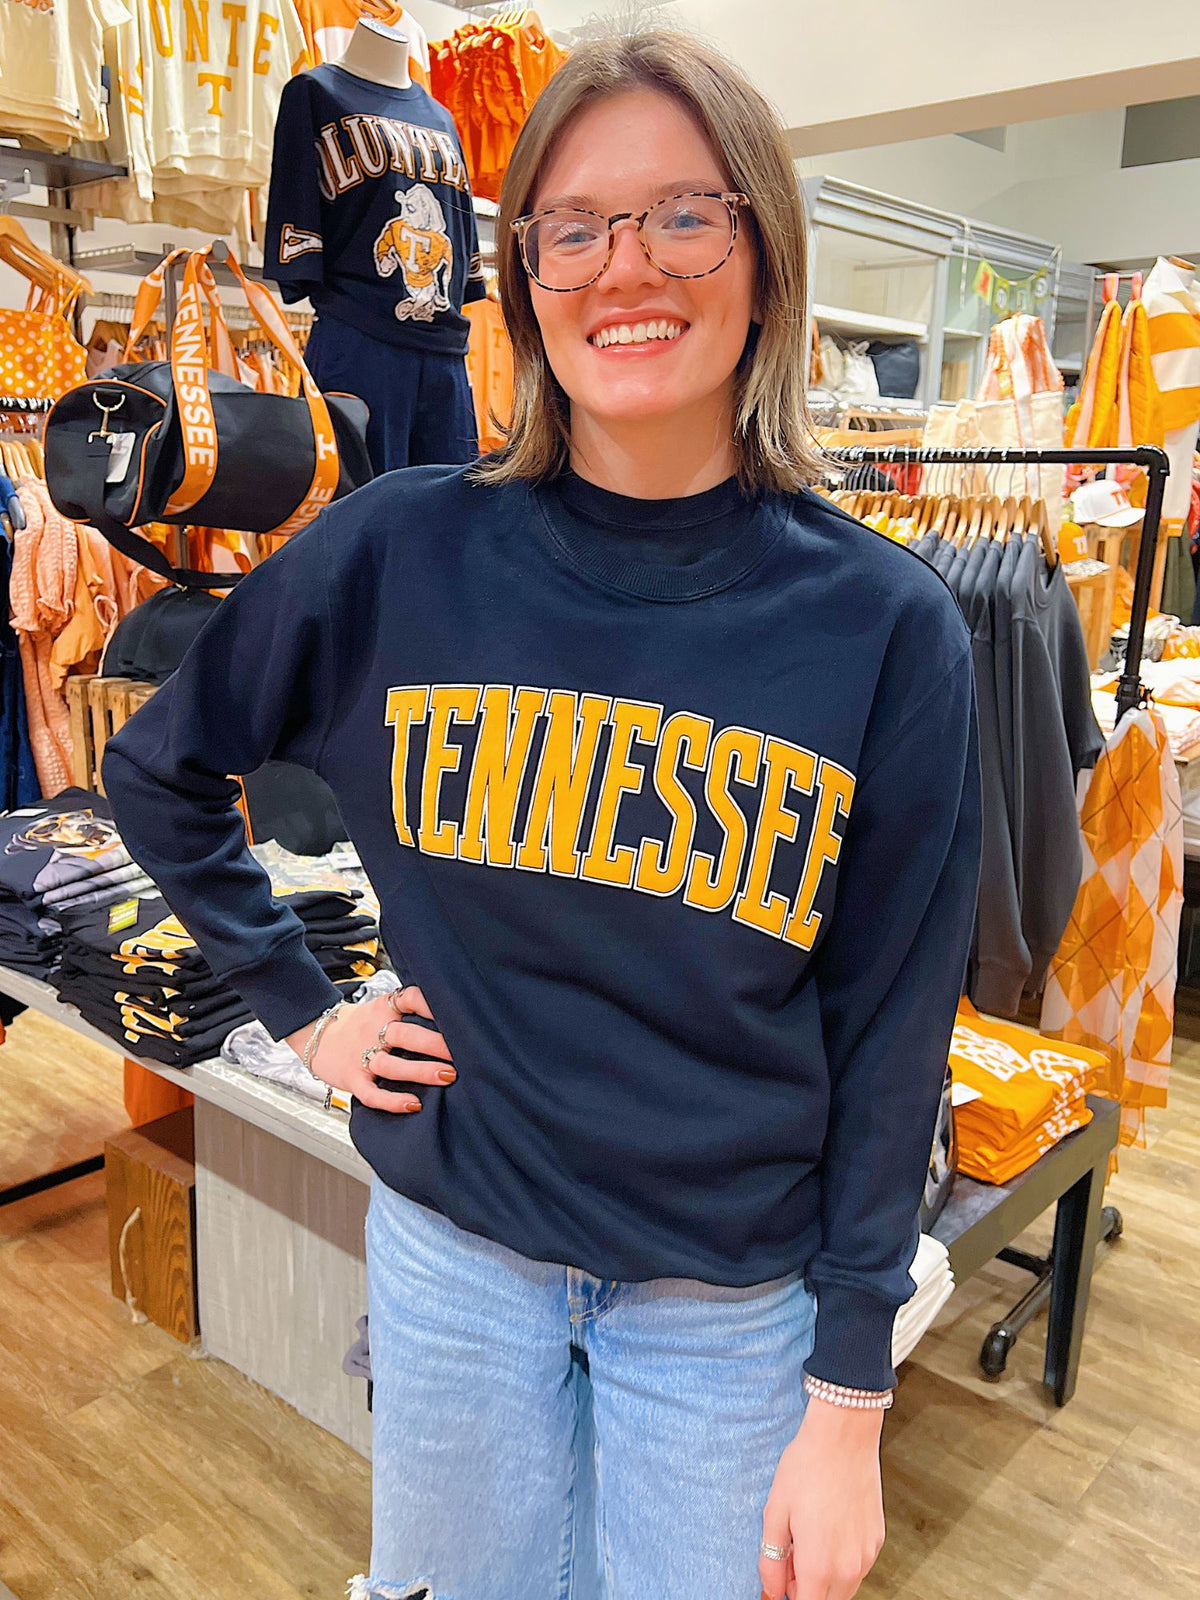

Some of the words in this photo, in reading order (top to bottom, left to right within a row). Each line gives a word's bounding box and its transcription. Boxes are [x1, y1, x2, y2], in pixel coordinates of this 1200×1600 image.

[198, 73, 232, 117] T
[400, 226, 431, 273] T
[175, 283, 214, 466] TENNESSEE
[384, 683, 857, 953] TENNESSEE
